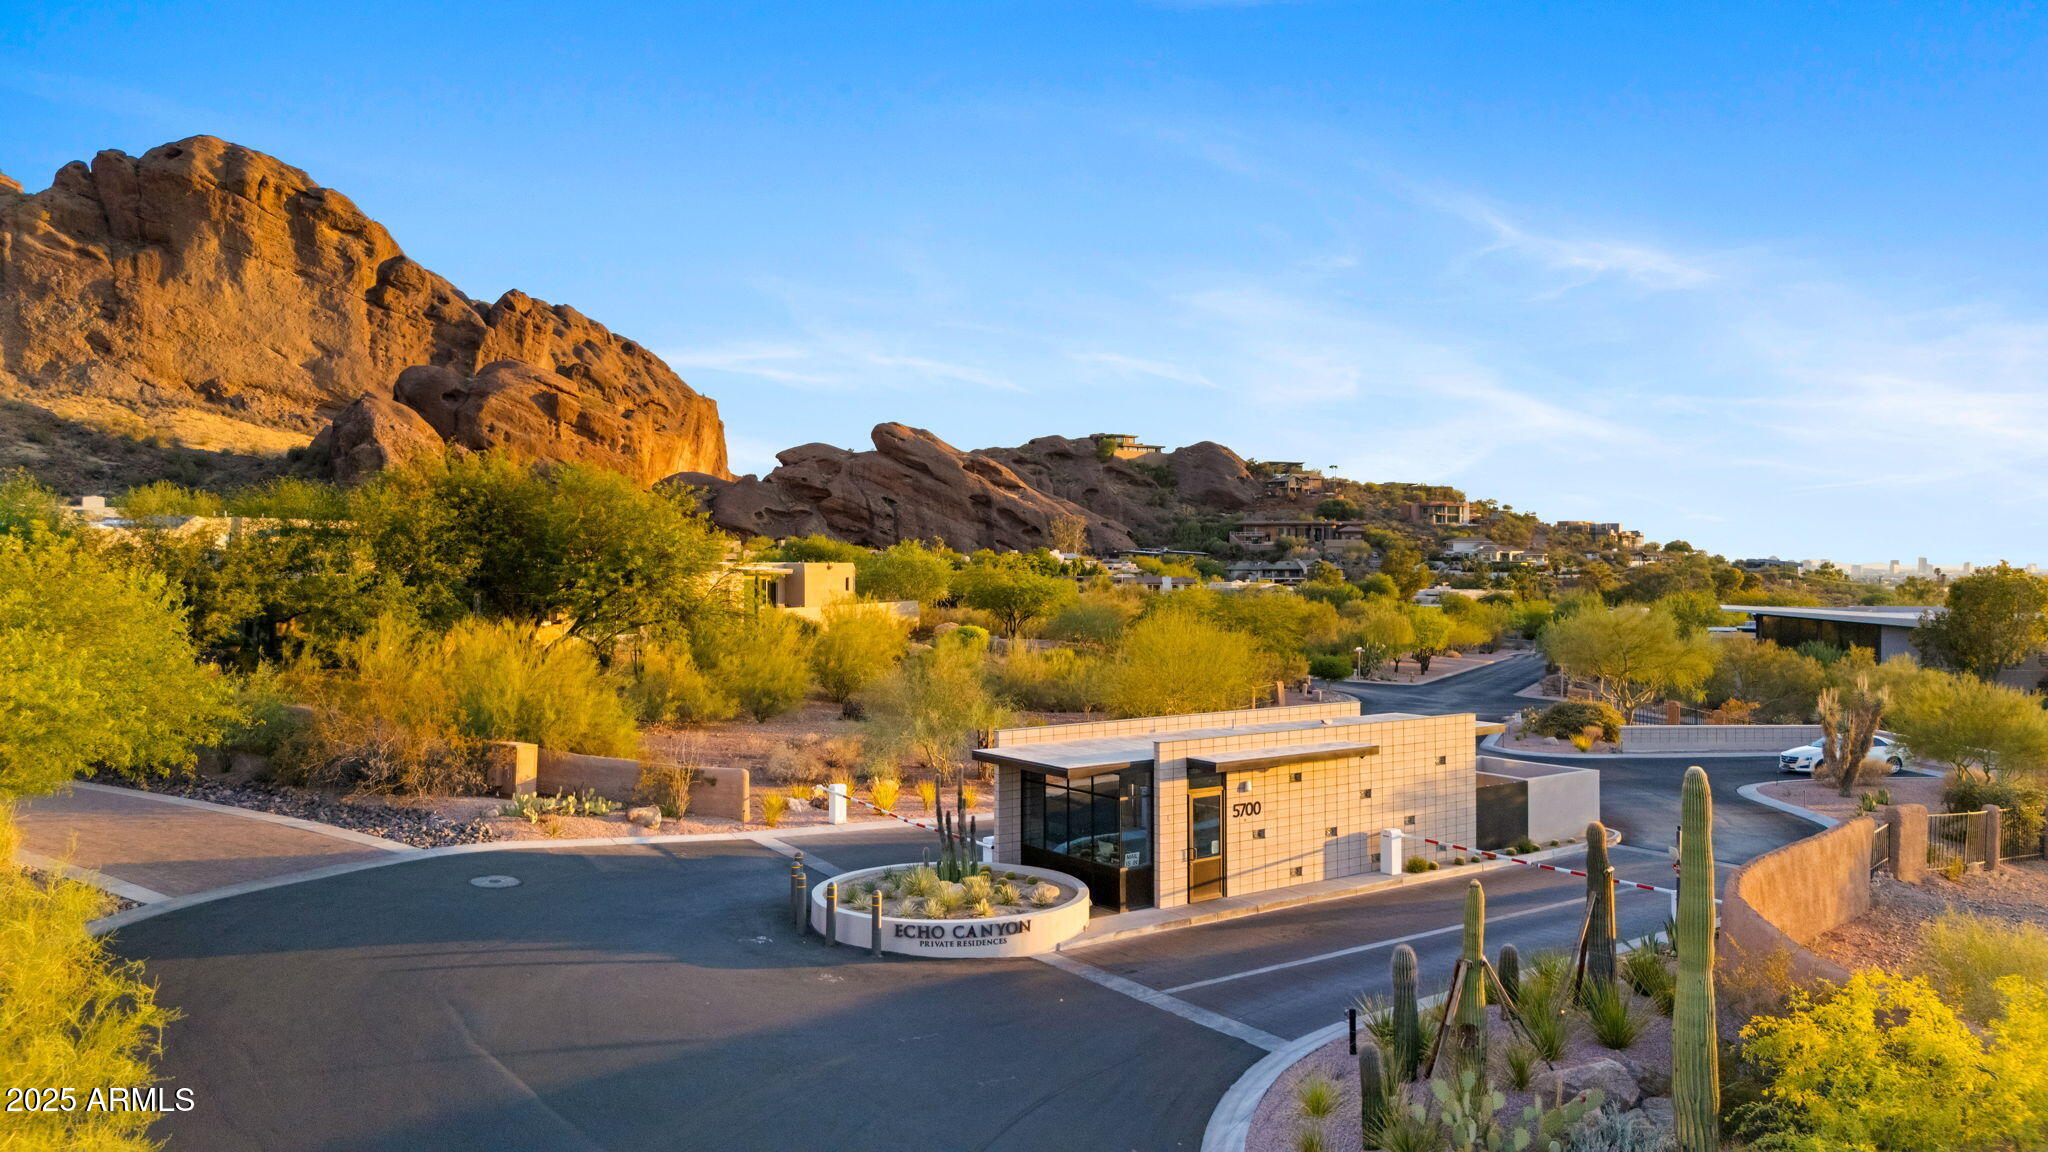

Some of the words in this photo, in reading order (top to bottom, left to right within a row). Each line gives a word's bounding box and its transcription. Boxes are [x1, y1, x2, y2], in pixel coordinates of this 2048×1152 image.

[1233, 801, 1261, 818] 5700
[895, 924, 945, 939] ECHO
[953, 920, 1031, 939] CANYON
[919, 940, 954, 948] PRIVATE
[957, 938, 1007, 948] RESIDENCES
